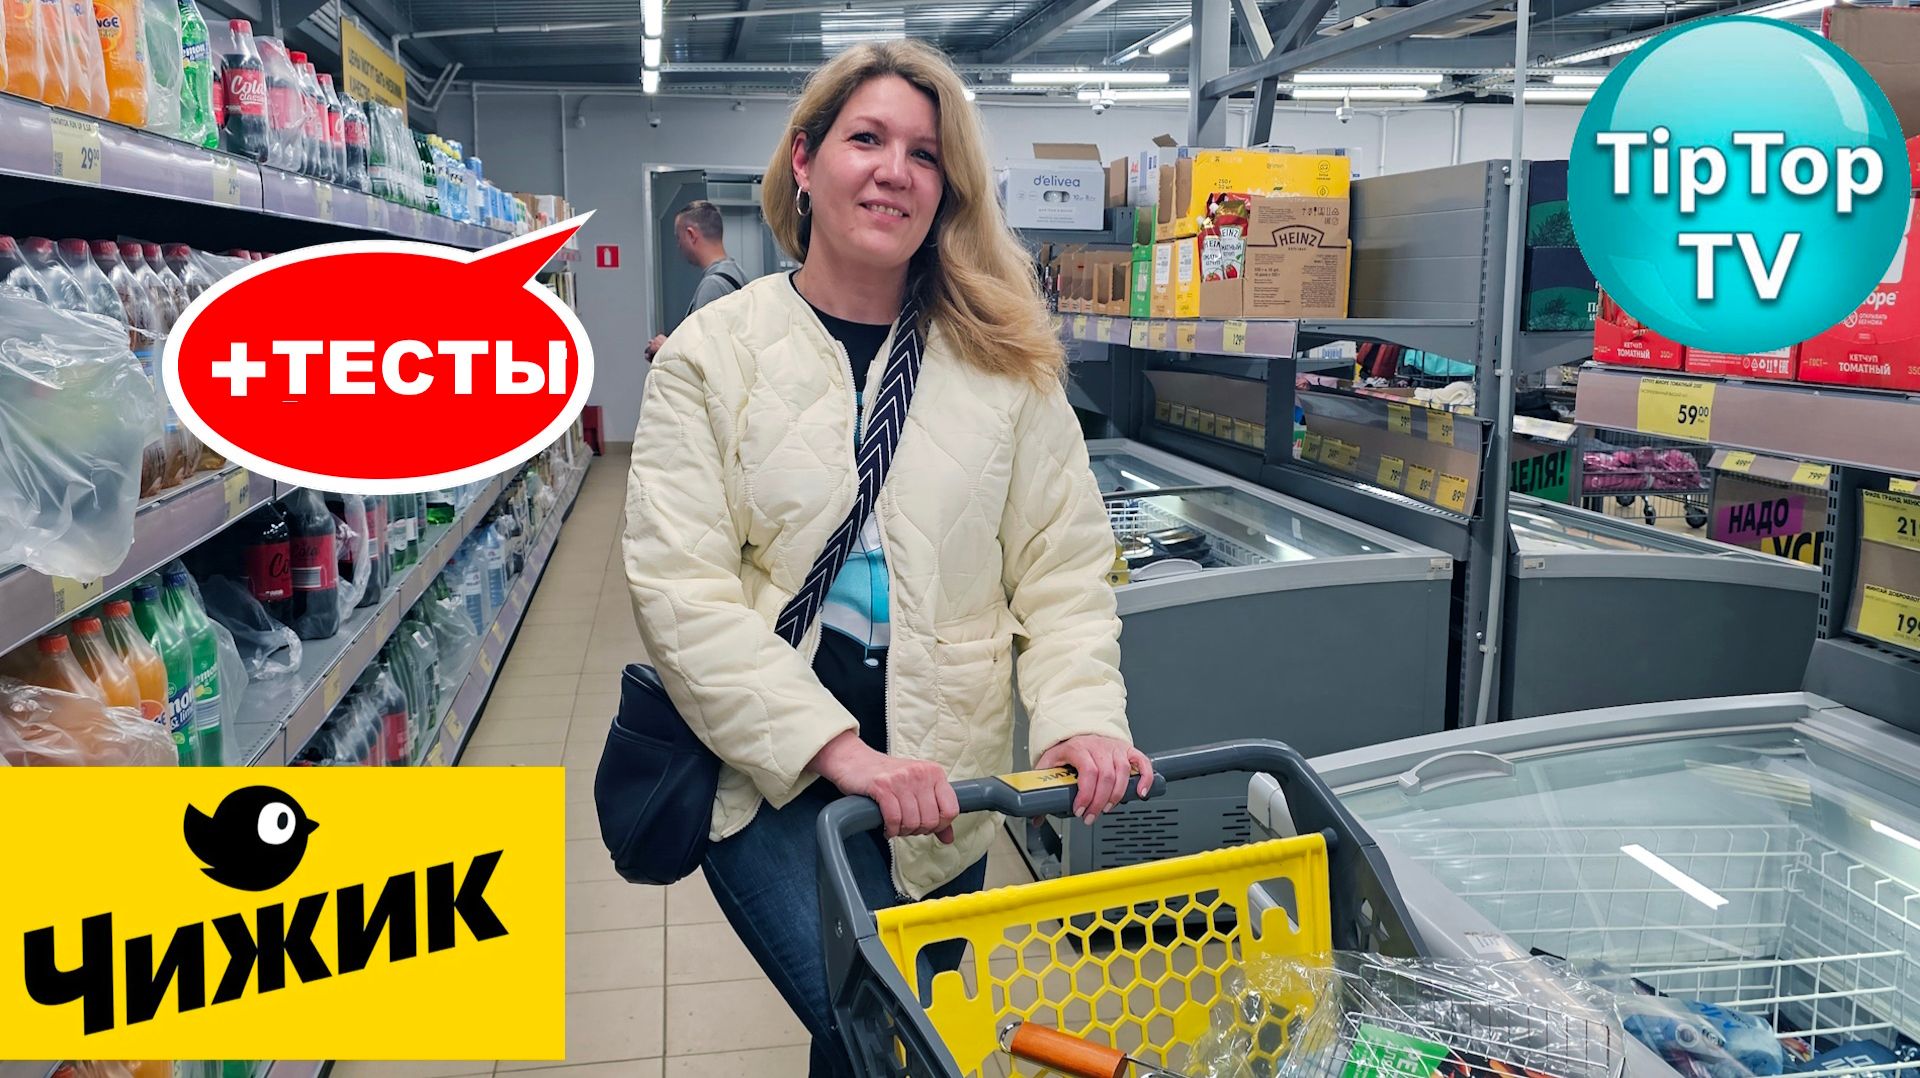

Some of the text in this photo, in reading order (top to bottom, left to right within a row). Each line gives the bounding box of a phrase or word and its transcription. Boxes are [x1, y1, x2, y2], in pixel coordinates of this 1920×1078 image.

[81, 147, 94, 170] 29
[1221, 228, 1238, 238] EINZ
[1279, 232, 1317, 247] HEINZ
[1864, 291, 1897, 310] оре
[1617, 348, 1650, 360] ТОМАТНЫЙ
[1849, 353, 1878, 363] КЕТЧУП
[1839, 361, 1891, 376] ТОМАТНЫЙ
[1677, 404, 1698, 425] 59
[1728, 498, 1789, 536] НАДО
